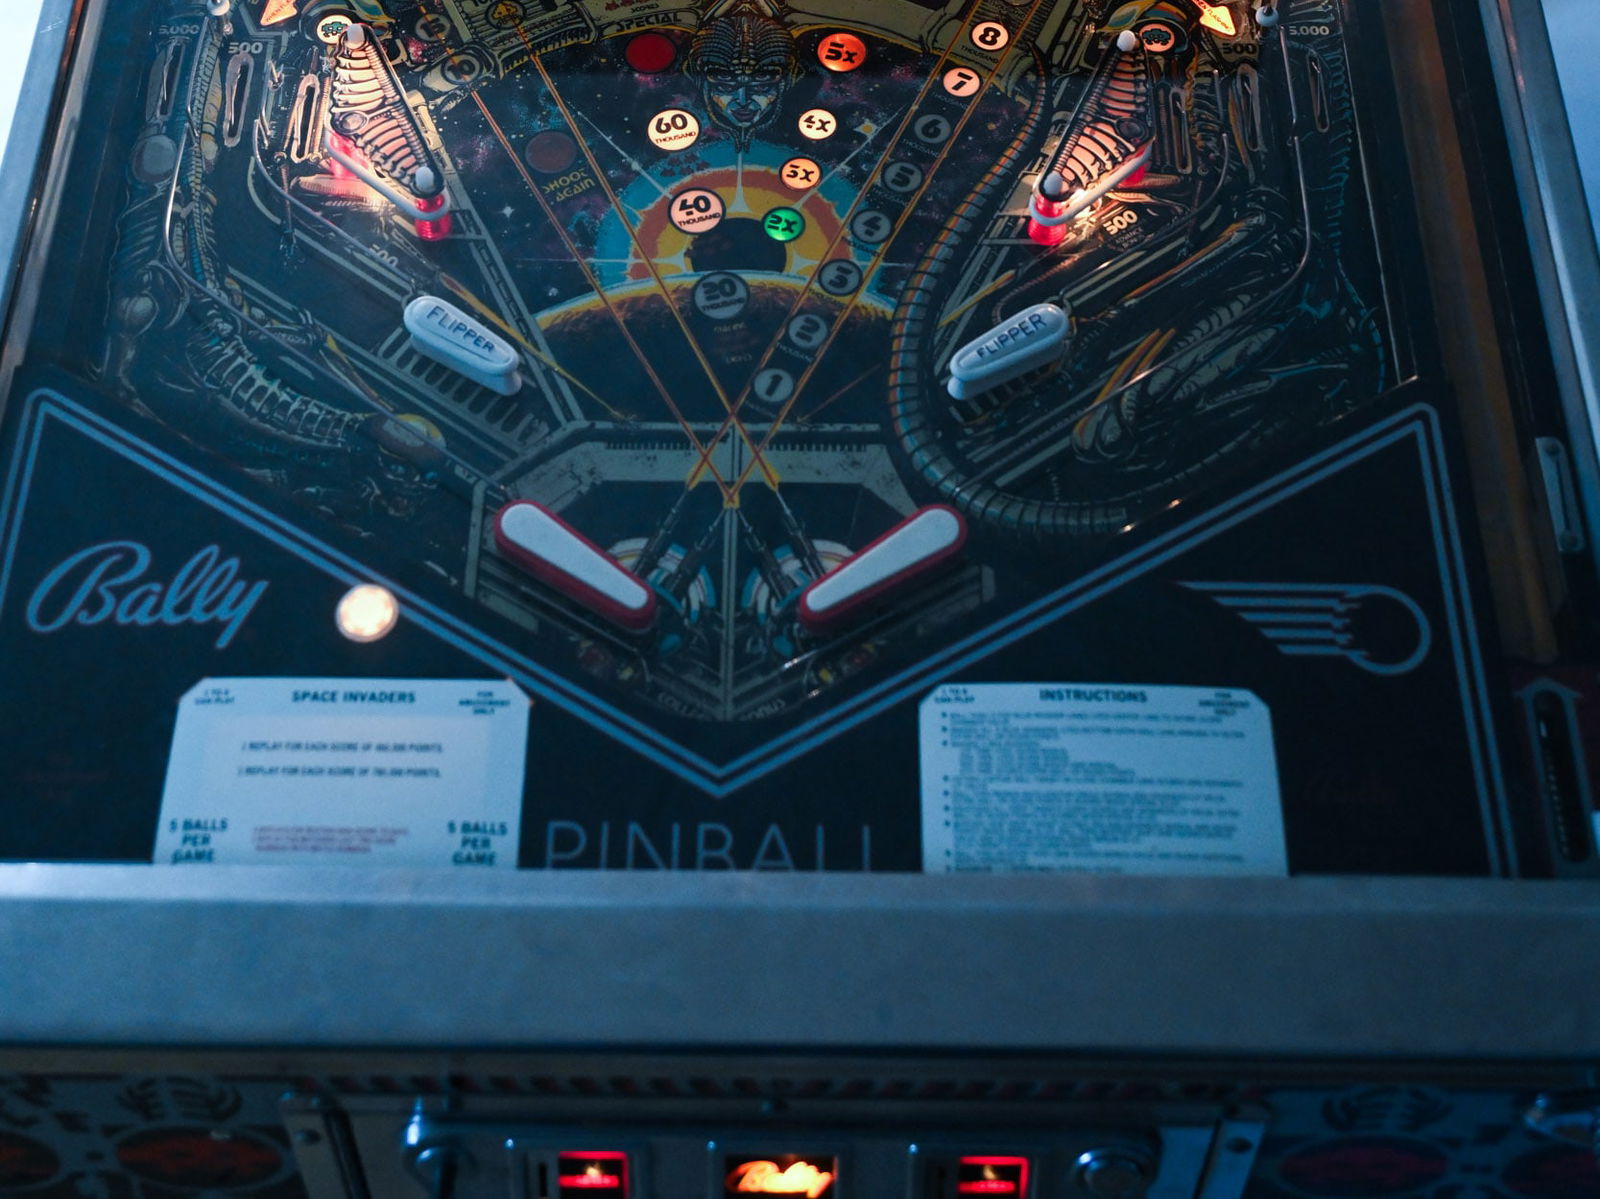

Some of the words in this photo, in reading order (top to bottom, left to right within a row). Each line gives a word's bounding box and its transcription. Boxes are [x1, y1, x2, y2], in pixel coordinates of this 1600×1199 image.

[615, 12, 682, 32] SPECIAL
[978, 26, 1001, 46] 8
[228, 41, 264, 55] 500
[951, 71, 974, 91] 7
[654, 113, 689, 135] 60
[921, 118, 942, 140] 6
[654, 130, 697, 145] THOUSAND
[541, 167, 588, 194] SHOOT
[891, 166, 915, 188] 5
[556, 177, 596, 202] AGAIN
[678, 194, 712, 216] 40
[677, 210, 721, 228] THOUSAND
[767, 214, 798, 234] 2X
[1103, 210, 1138, 235] 500
[702, 278, 738, 301] 20
[426, 305, 496, 353] FLIPPER
[795, 316, 821, 343] 2
[975, 312, 1048, 359] FLIPPER
[766, 374, 783, 397] 1
[26, 539, 269, 649] Bally
[292, 690, 338, 703] SPACE
[343, 691, 417, 704] INVADERS
[1039, 688, 1148, 702] INSTRUCTIONS
[182, 818, 228, 833] BALLS
[460, 820, 508, 835] BALLS
[182, 833, 211, 847] PER
[461, 836, 492, 850] PER
